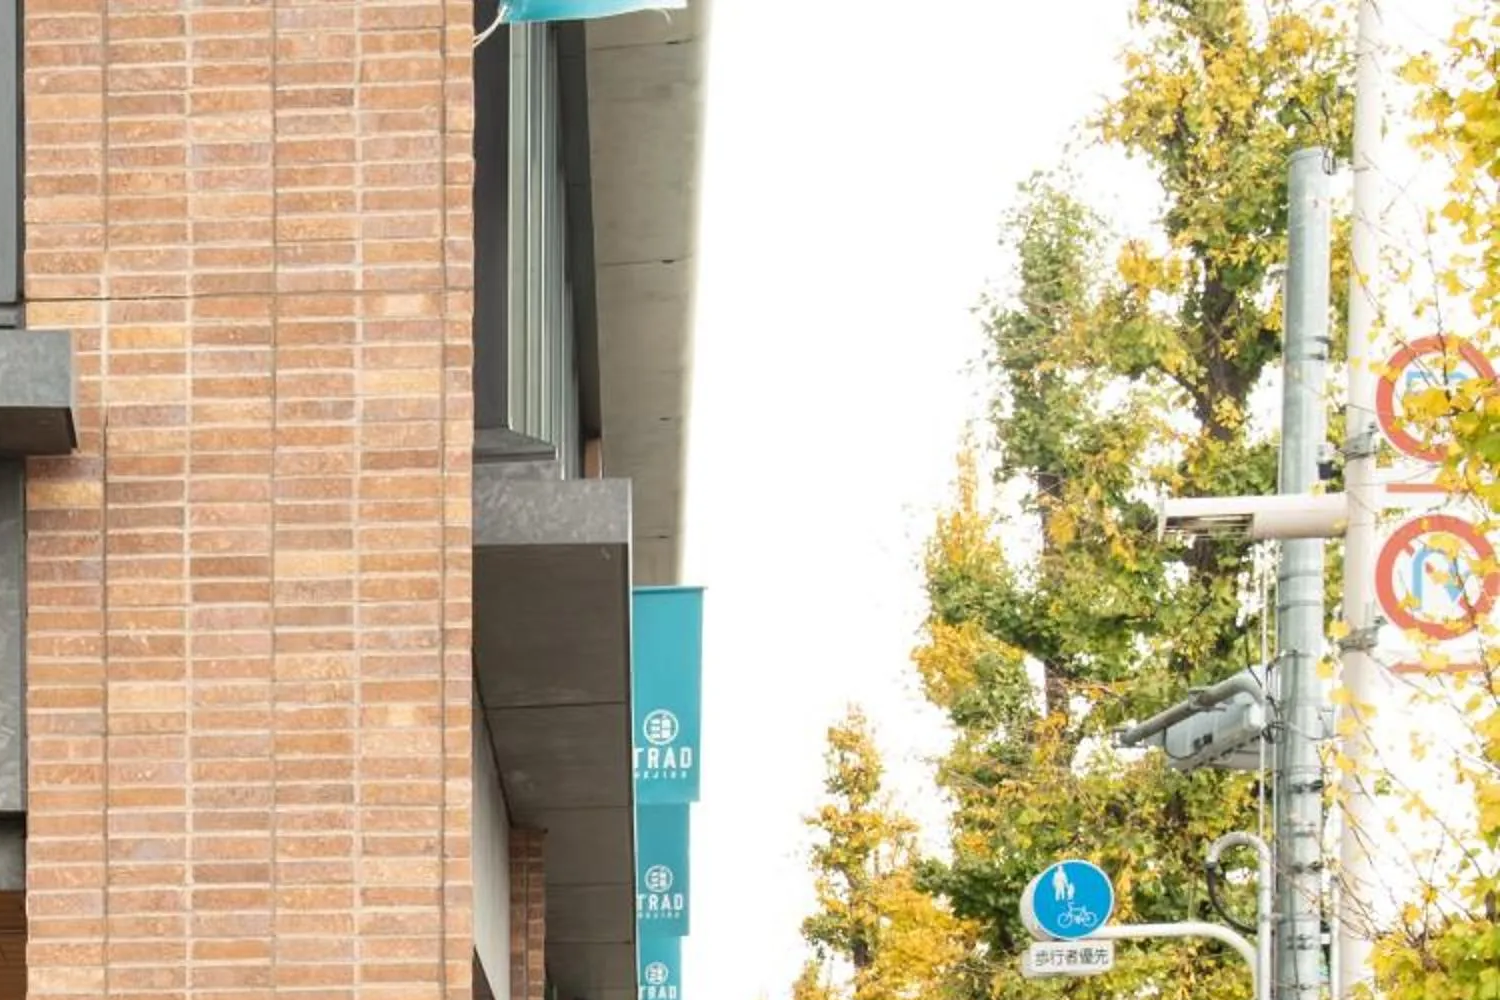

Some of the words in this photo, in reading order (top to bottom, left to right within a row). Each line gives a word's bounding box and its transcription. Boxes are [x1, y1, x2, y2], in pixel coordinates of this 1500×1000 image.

[632, 747, 692, 769] TRAD
[1035, 947, 1109, 967] 歩行者優先
